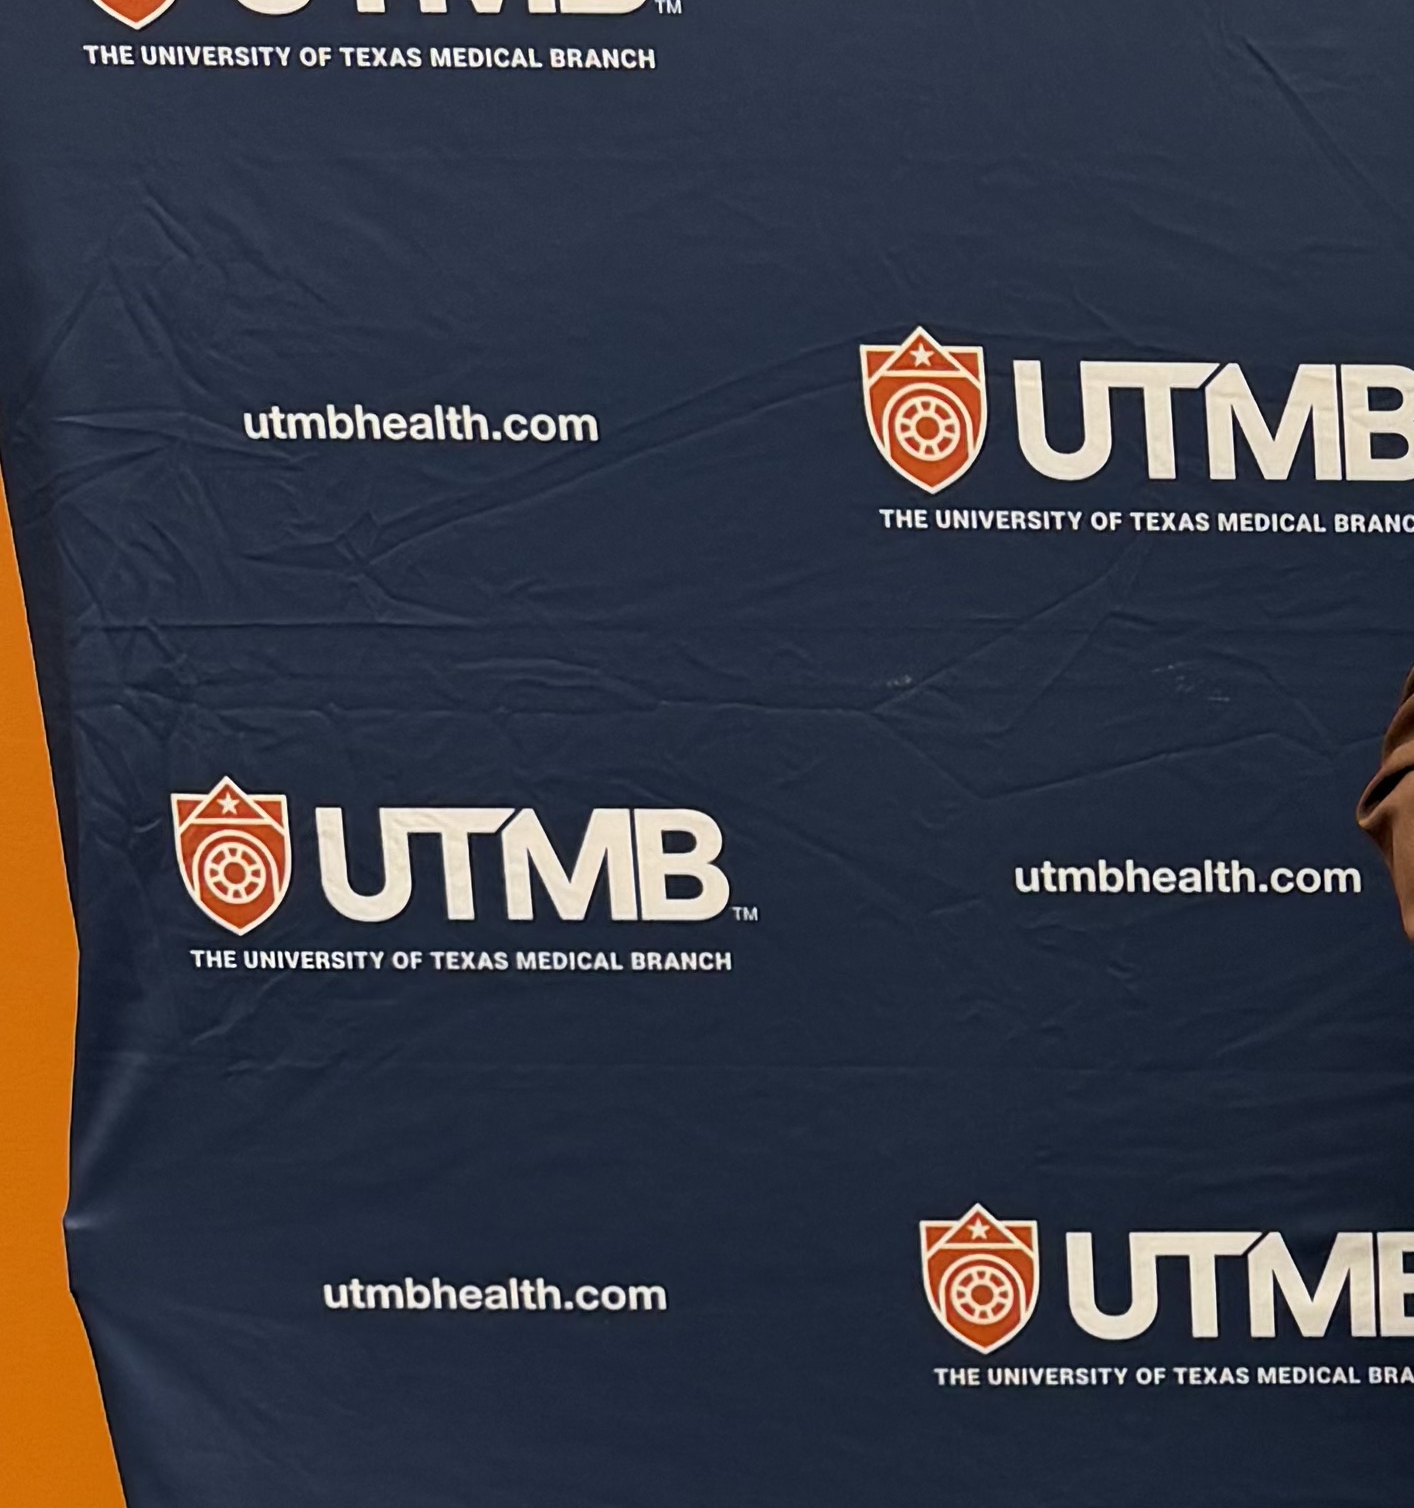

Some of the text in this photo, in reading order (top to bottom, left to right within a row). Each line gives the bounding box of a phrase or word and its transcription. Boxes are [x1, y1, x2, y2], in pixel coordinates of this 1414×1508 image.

[243, 403, 599, 442] utmbhealth.com
[878, 508, 929, 529] THE
[935, 509, 1083, 531] UNIVERSITY
[1090, 511, 1122, 531] OF
[1129, 511, 1210, 532] TEXAS
[1217, 512, 1327, 533] MEDICAL
[315, 807, 729, 922] UTMB
[1014, 859, 1362, 893] utmbhealth.com
[189, 949, 732, 971] THE UNIVERSITY OF TEXAS MEDICAL BRANCH
[323, 1277, 667, 1311] utmbhealth.com
